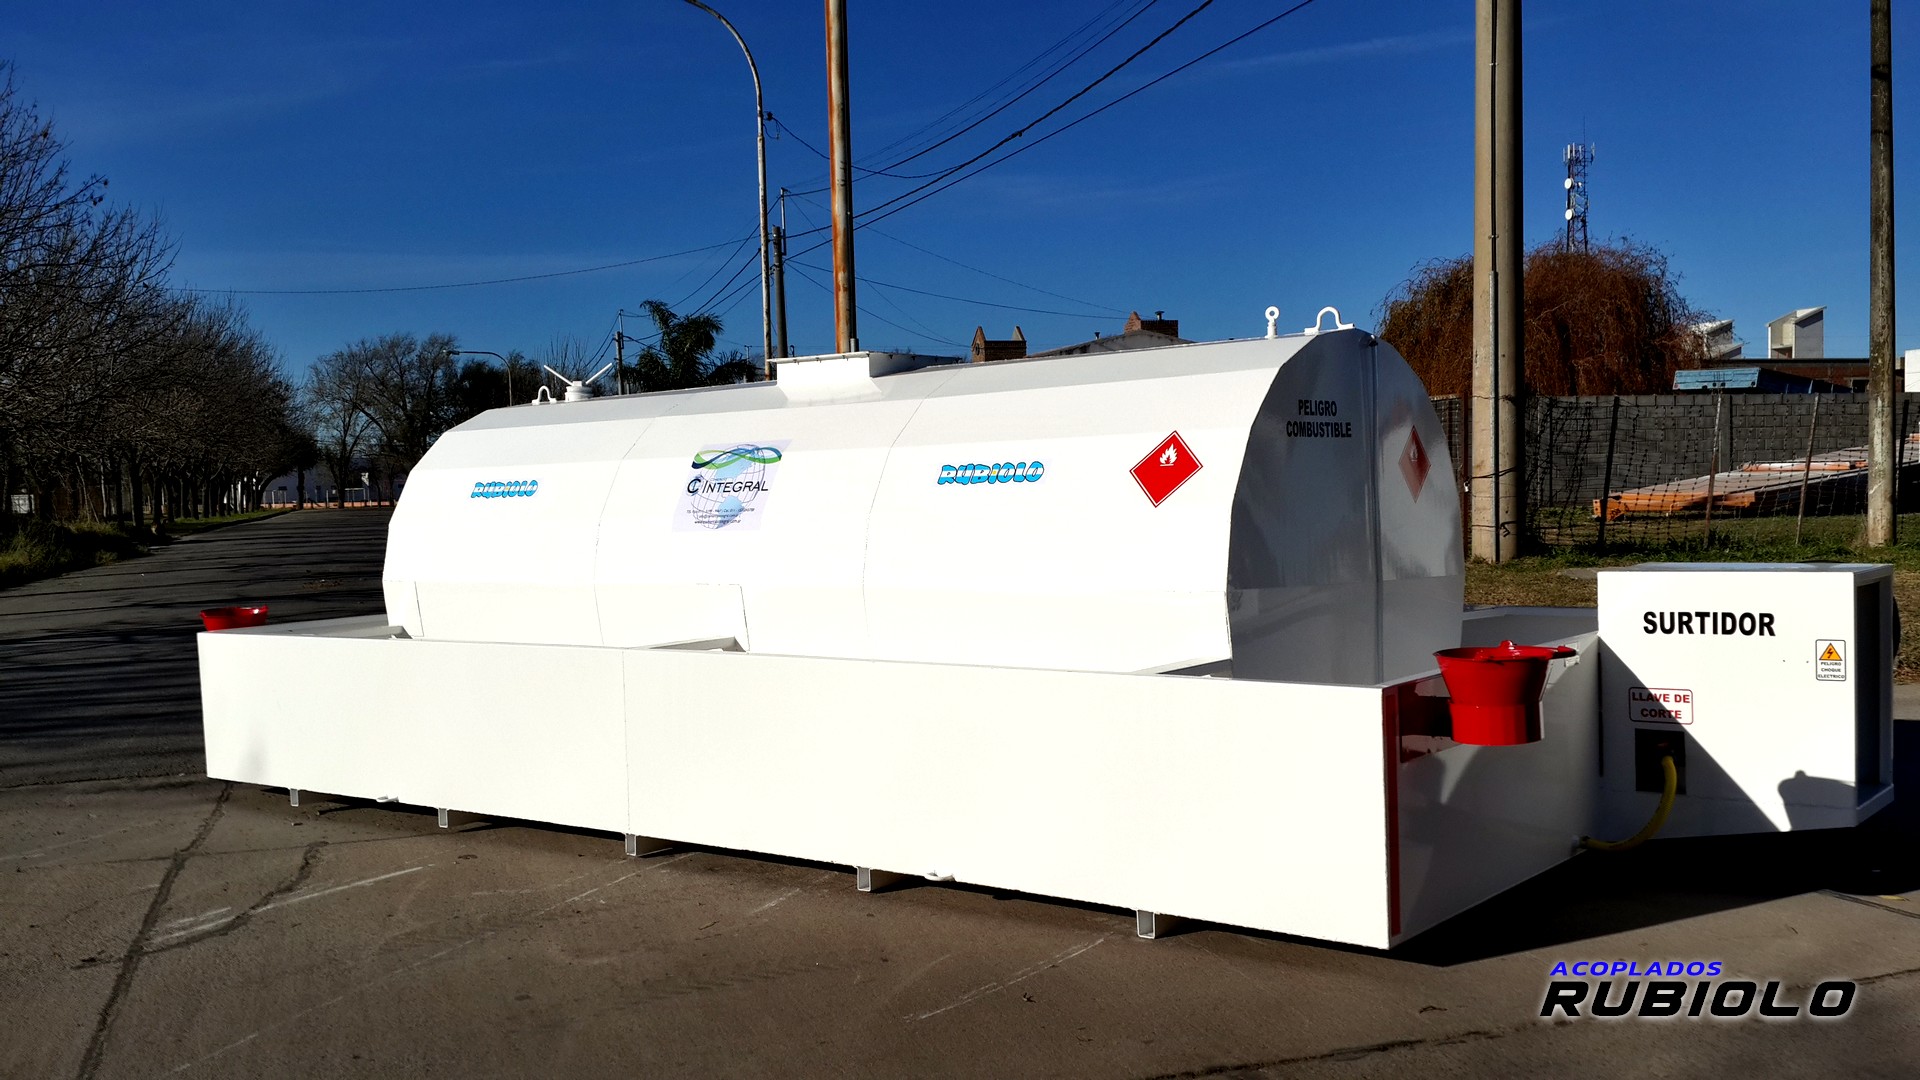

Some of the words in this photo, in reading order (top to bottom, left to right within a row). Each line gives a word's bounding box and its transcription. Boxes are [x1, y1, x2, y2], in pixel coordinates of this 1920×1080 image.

[1298, 400, 1337, 416] PELIGRO
[1286, 421, 1352, 437] COMBUSTIBLE
[937, 461, 1044, 485] RUBIOLO
[471, 480, 539, 499] RUBIOLO
[1643, 611, 1776, 636] SURTIDOR
[1632, 692, 1670, 702] LLAVE
[1674, 694, 1690, 703] DE
[1640, 708, 1682, 719] CORTE
